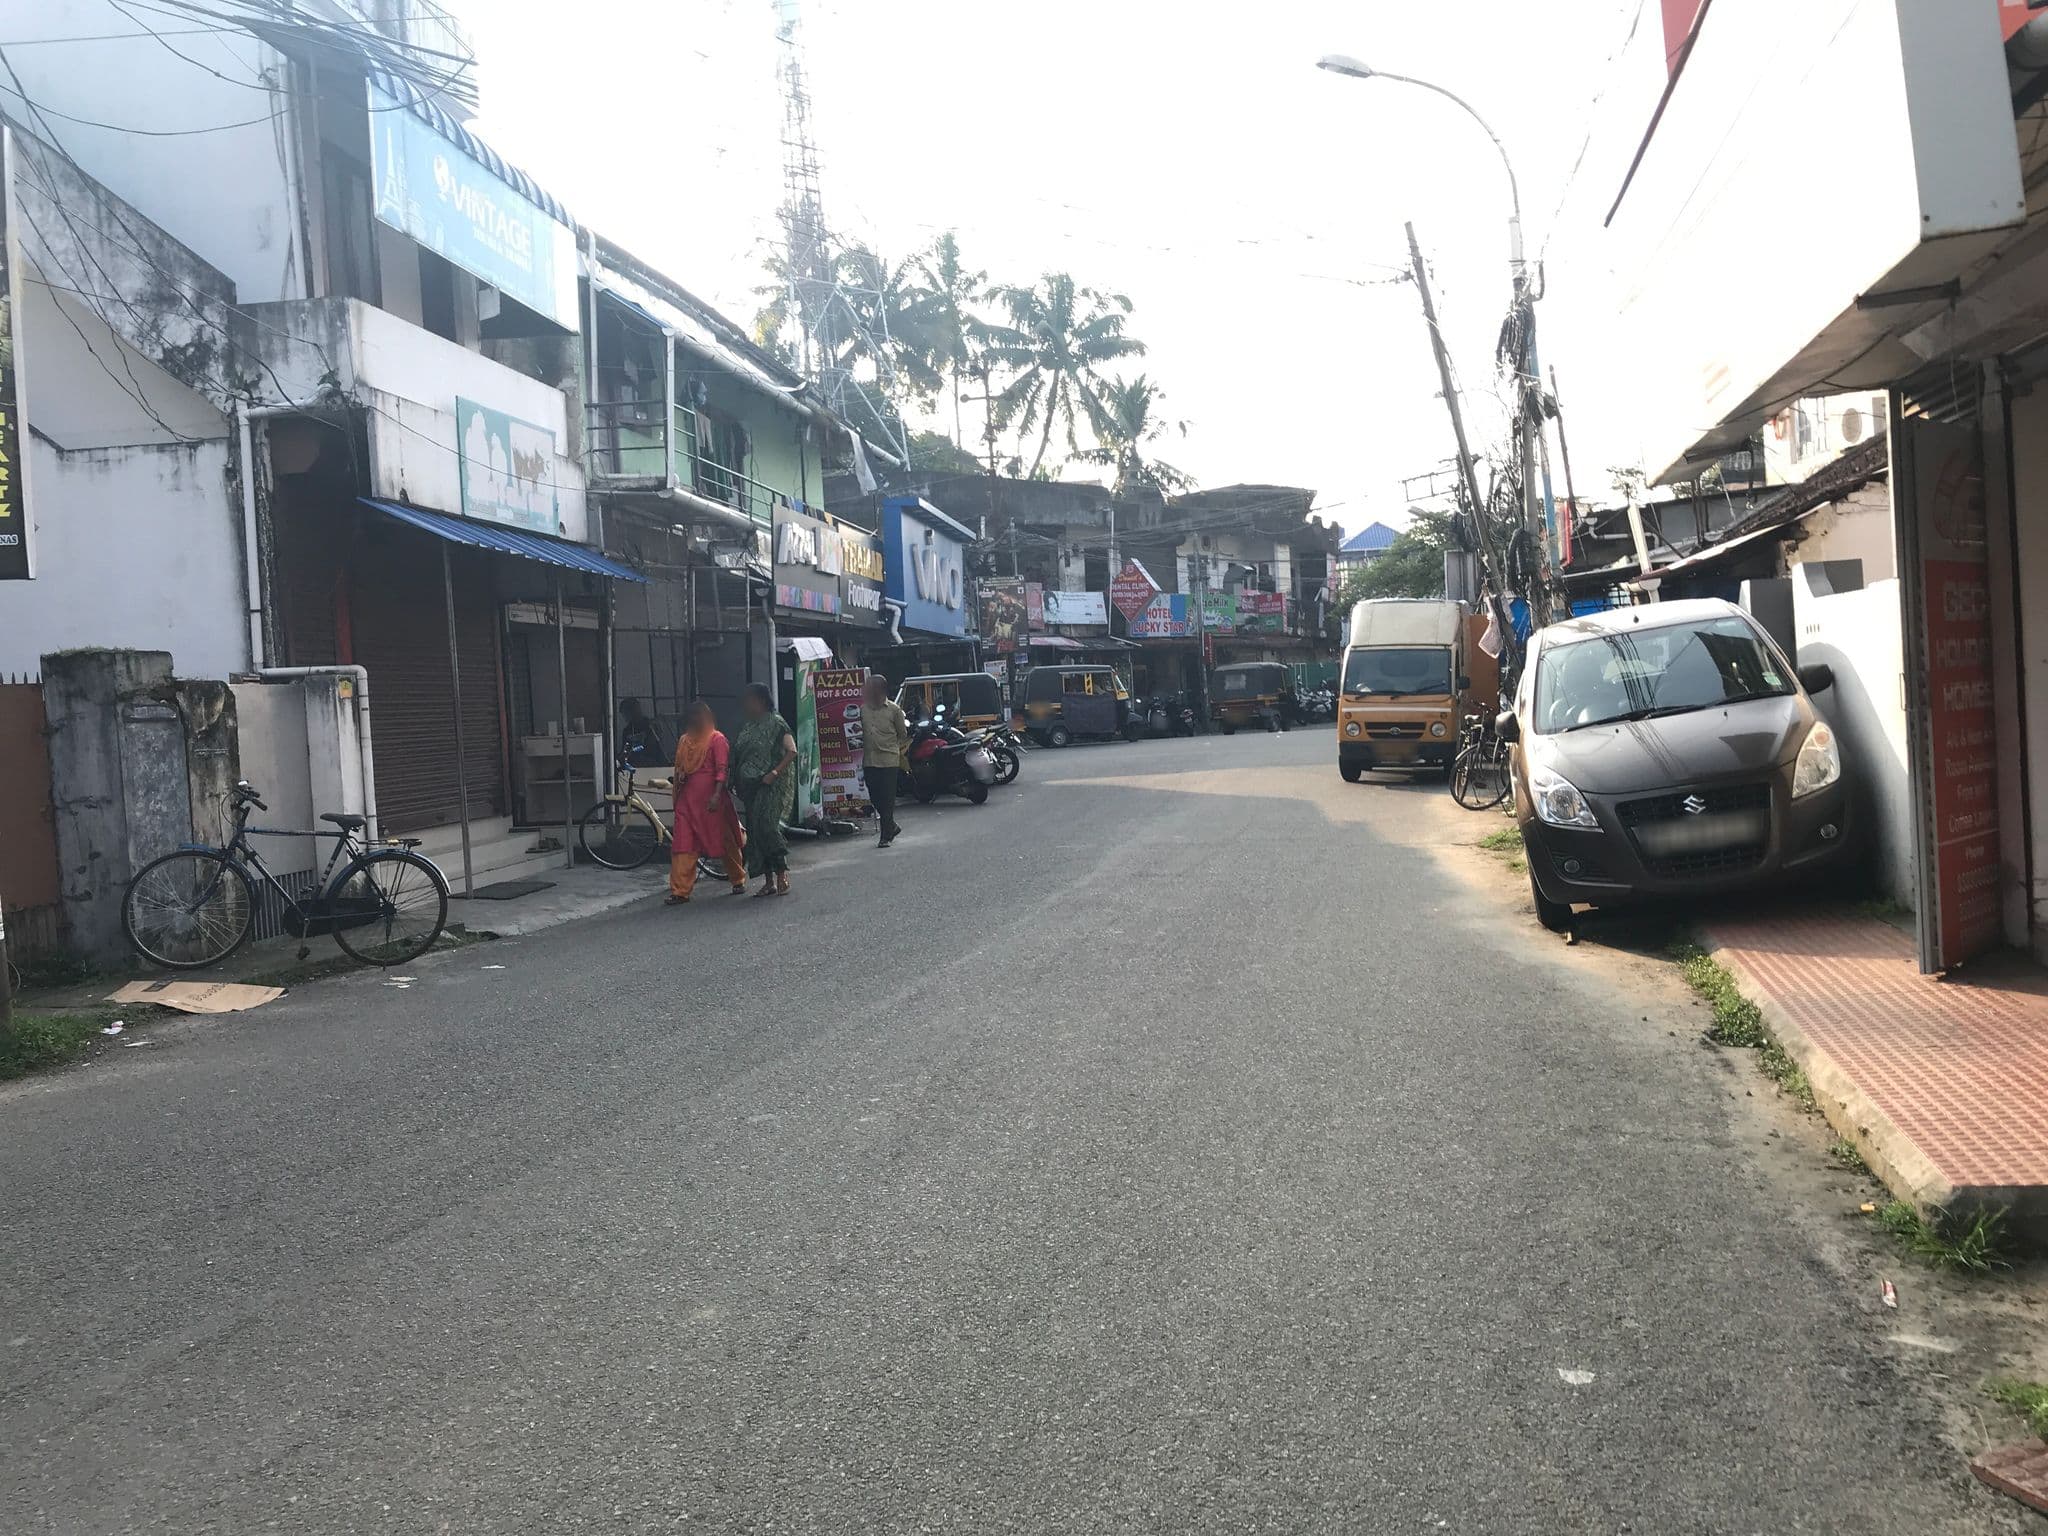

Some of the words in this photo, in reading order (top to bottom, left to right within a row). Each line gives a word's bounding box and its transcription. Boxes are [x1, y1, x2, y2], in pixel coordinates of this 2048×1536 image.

[449, 175, 531, 255] VINTAGE
[848, 580, 881, 611] Footwear
[1147, 608, 1172, 619] HOTEL
[1133, 621, 1160, 633] LUCKY
[1163, 621, 1185, 633] STAR
[816, 674, 863, 688] AZZAL
[817, 689, 833, 698] HOT
[834, 689, 841, 698] &
[820, 727, 840, 735] COFFEE
